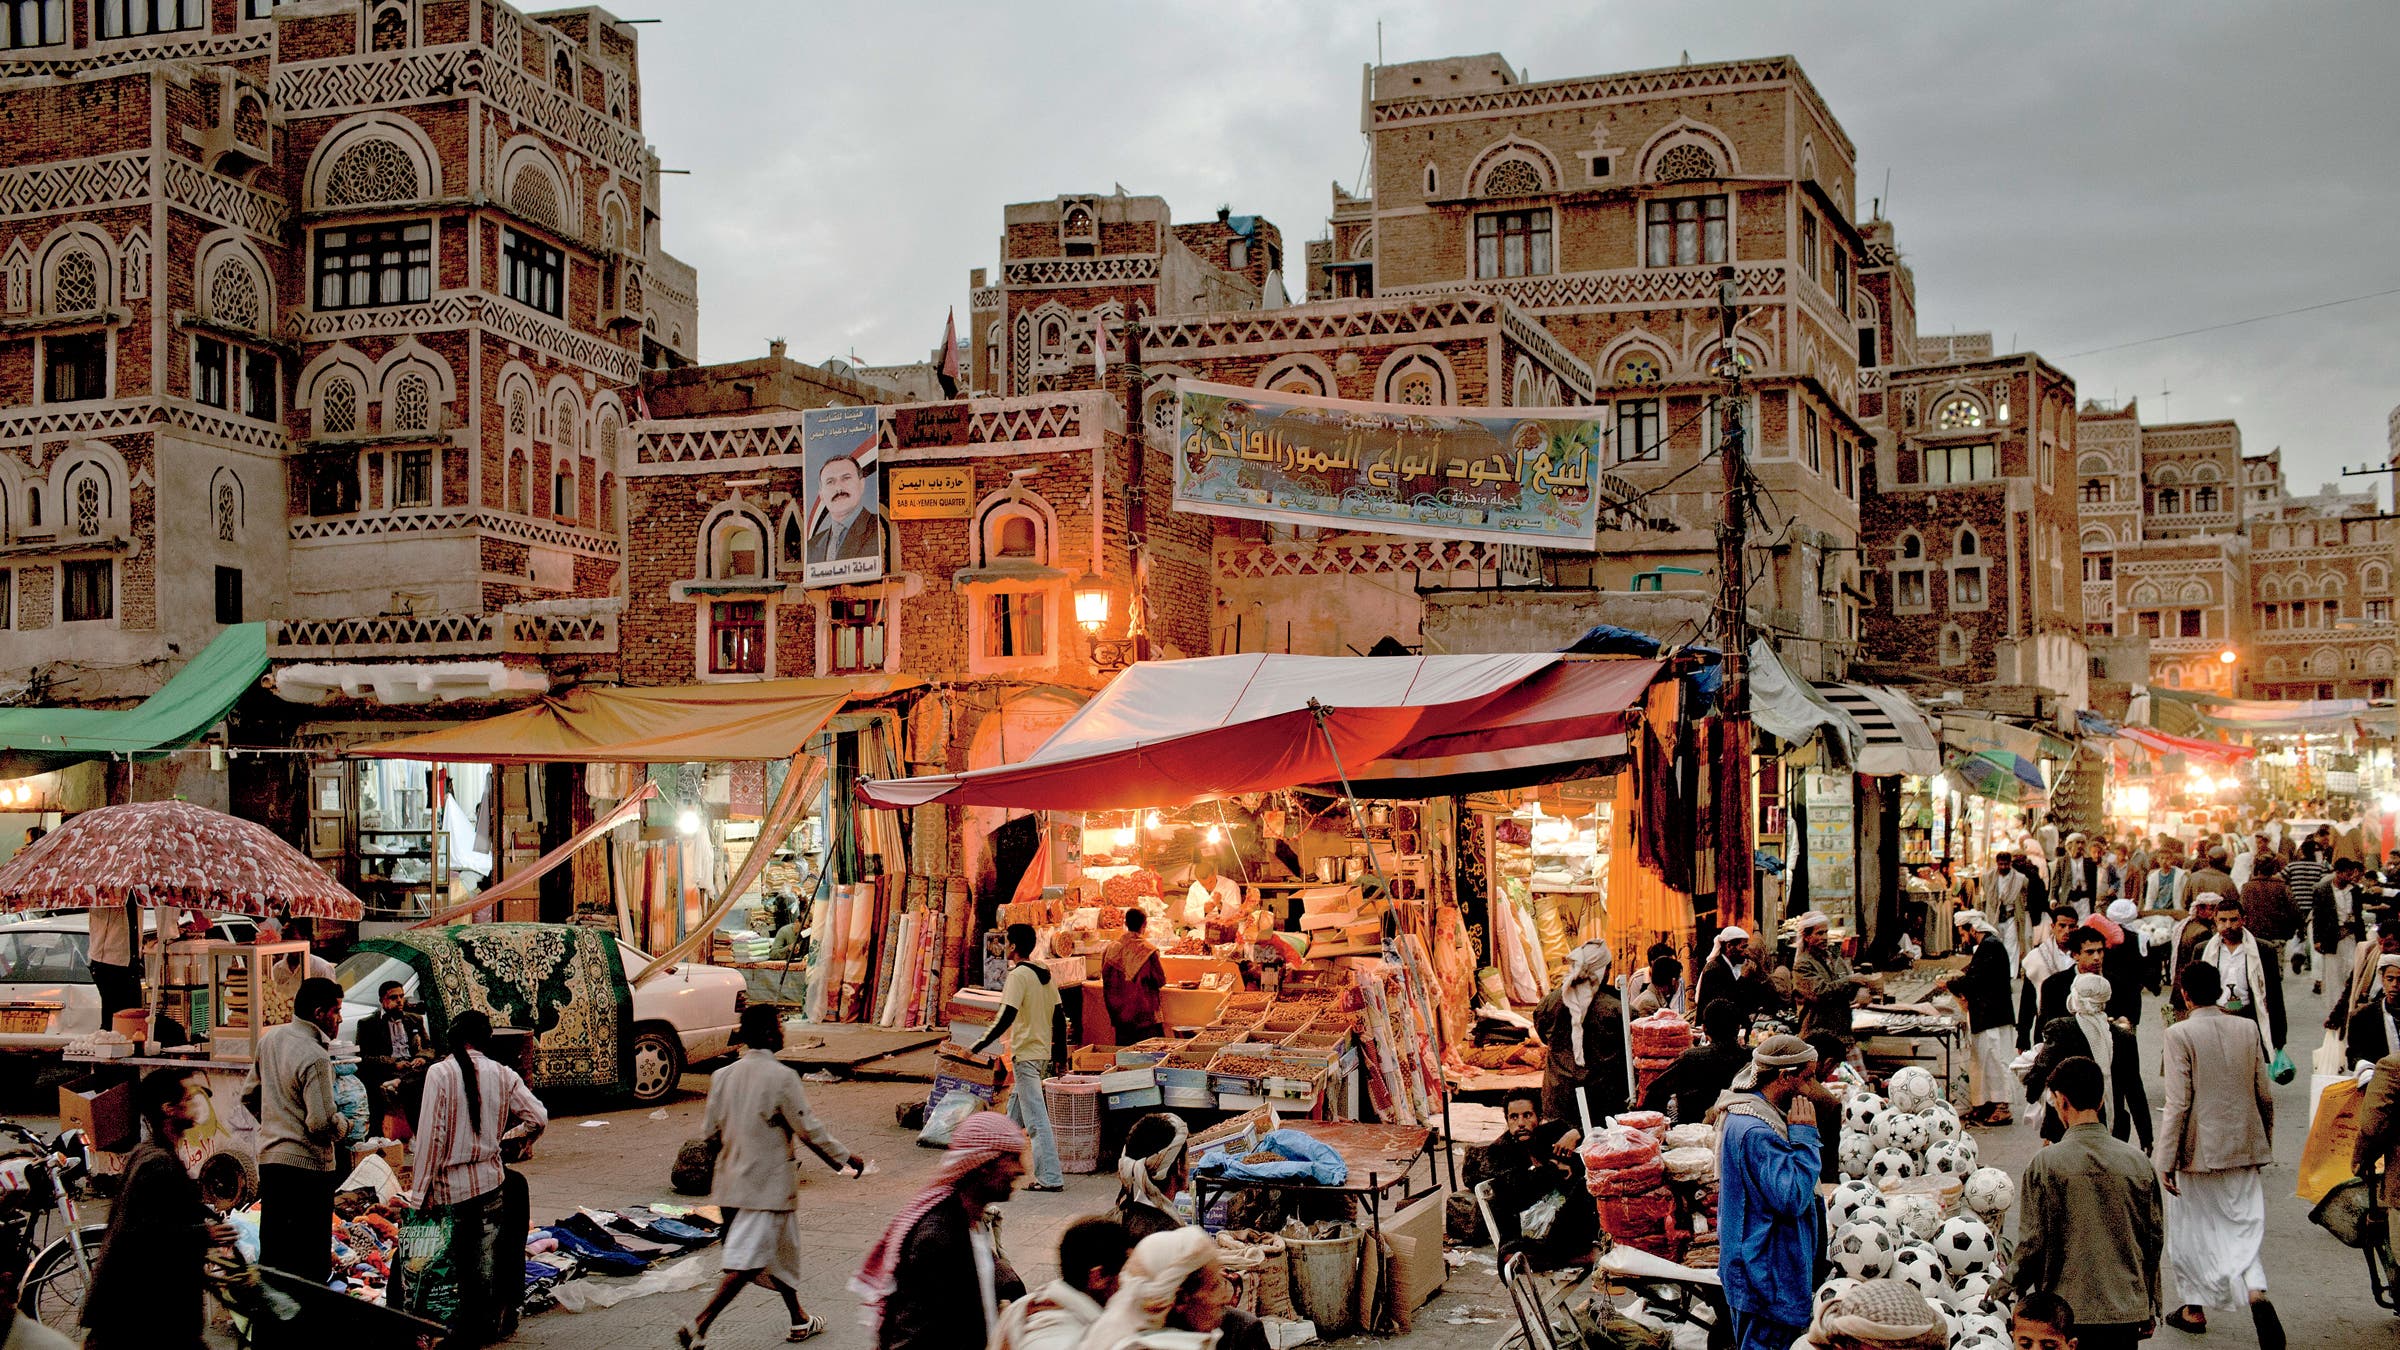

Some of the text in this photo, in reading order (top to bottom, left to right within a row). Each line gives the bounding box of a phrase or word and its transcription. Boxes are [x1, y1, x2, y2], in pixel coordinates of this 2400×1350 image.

[1532, 446, 1588, 496] لبيع
[898, 476, 964, 491] حارة باب اليمن
[897, 498, 966, 508] BAB AL-YEMEN QUARTER
[810, 564, 851, 578] العاصمة
